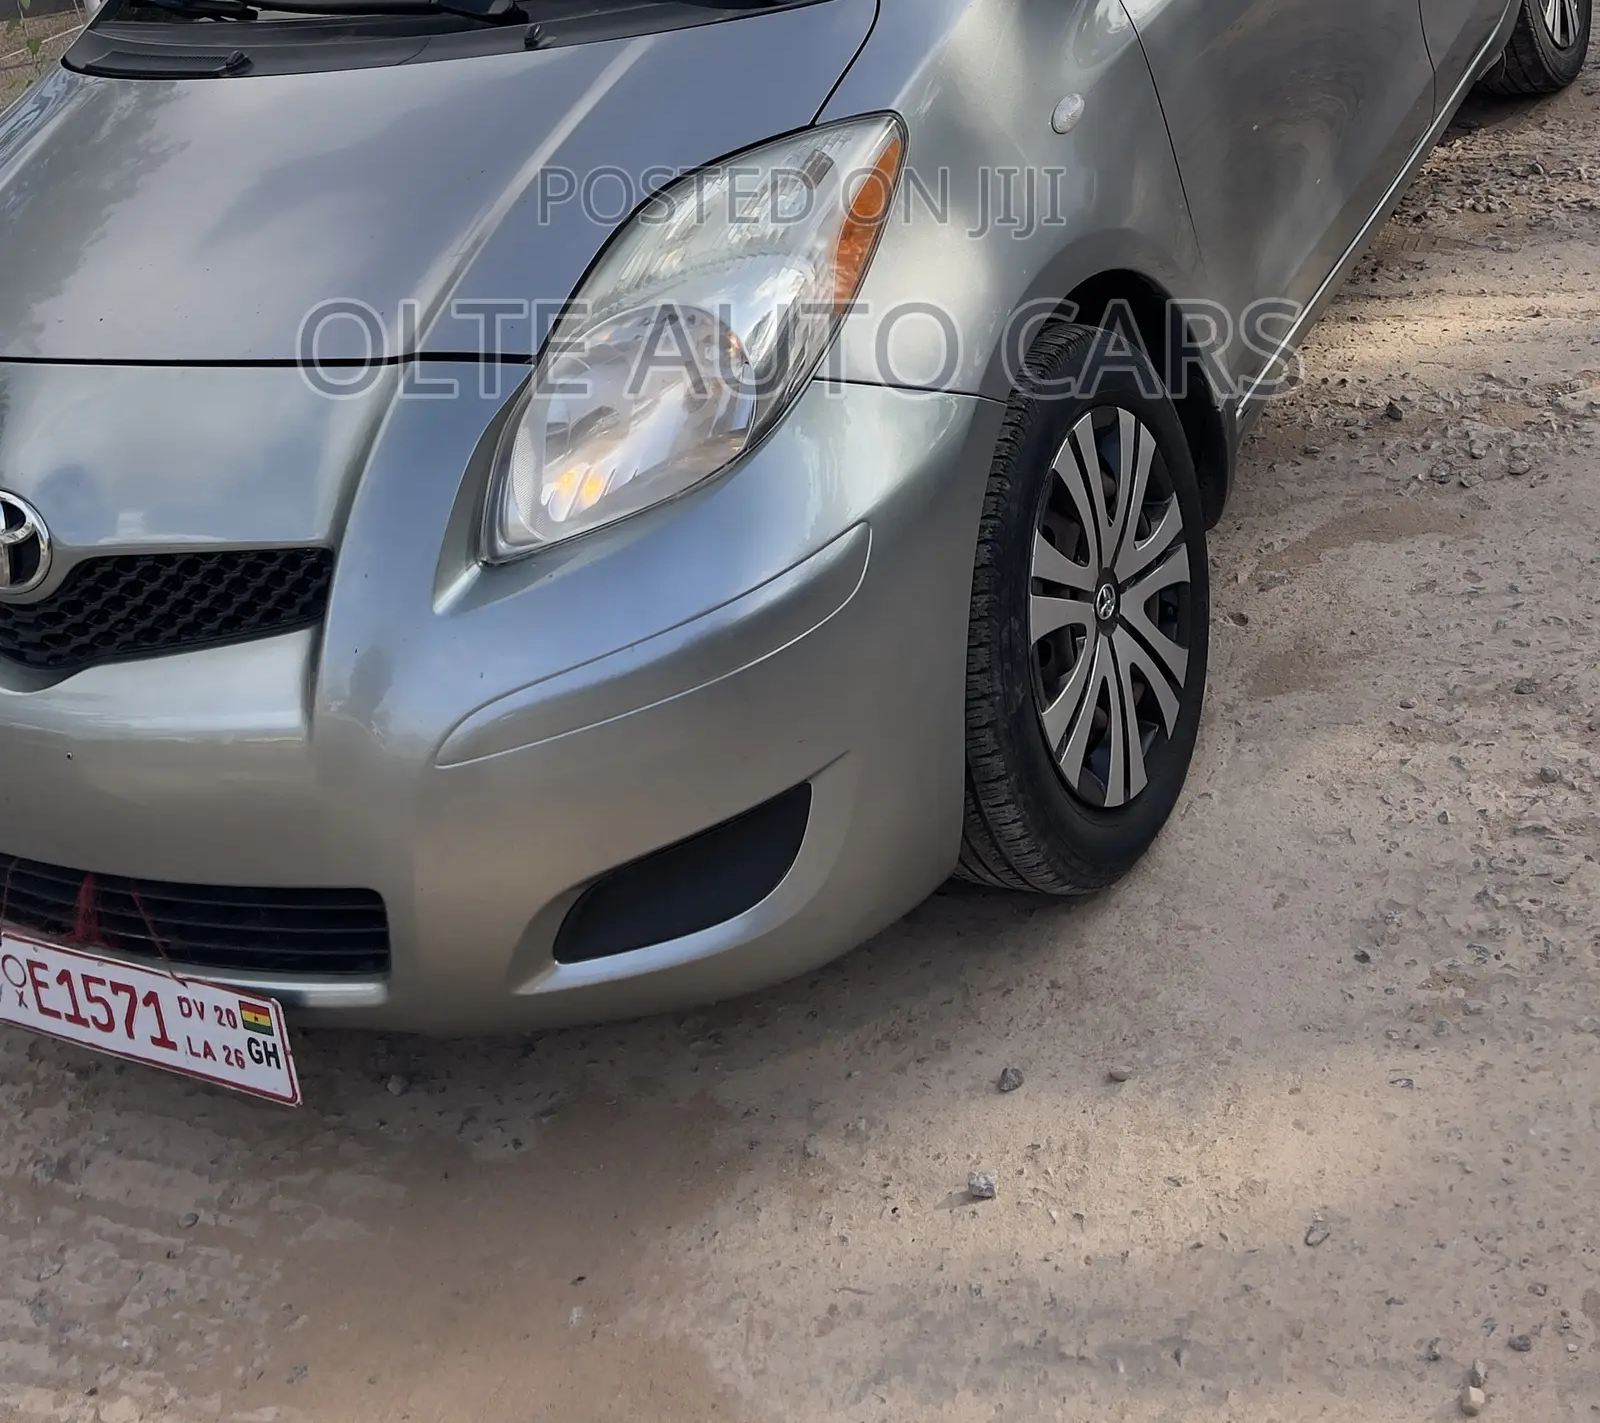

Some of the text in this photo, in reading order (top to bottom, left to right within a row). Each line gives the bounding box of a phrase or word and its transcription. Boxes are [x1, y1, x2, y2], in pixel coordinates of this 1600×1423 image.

[26, 958, 178, 1051] E1571
[177, 995, 238, 1030] DV 20
[187, 1035, 246, 1070] LA 26
[247, 1036, 281, 1070] GH
